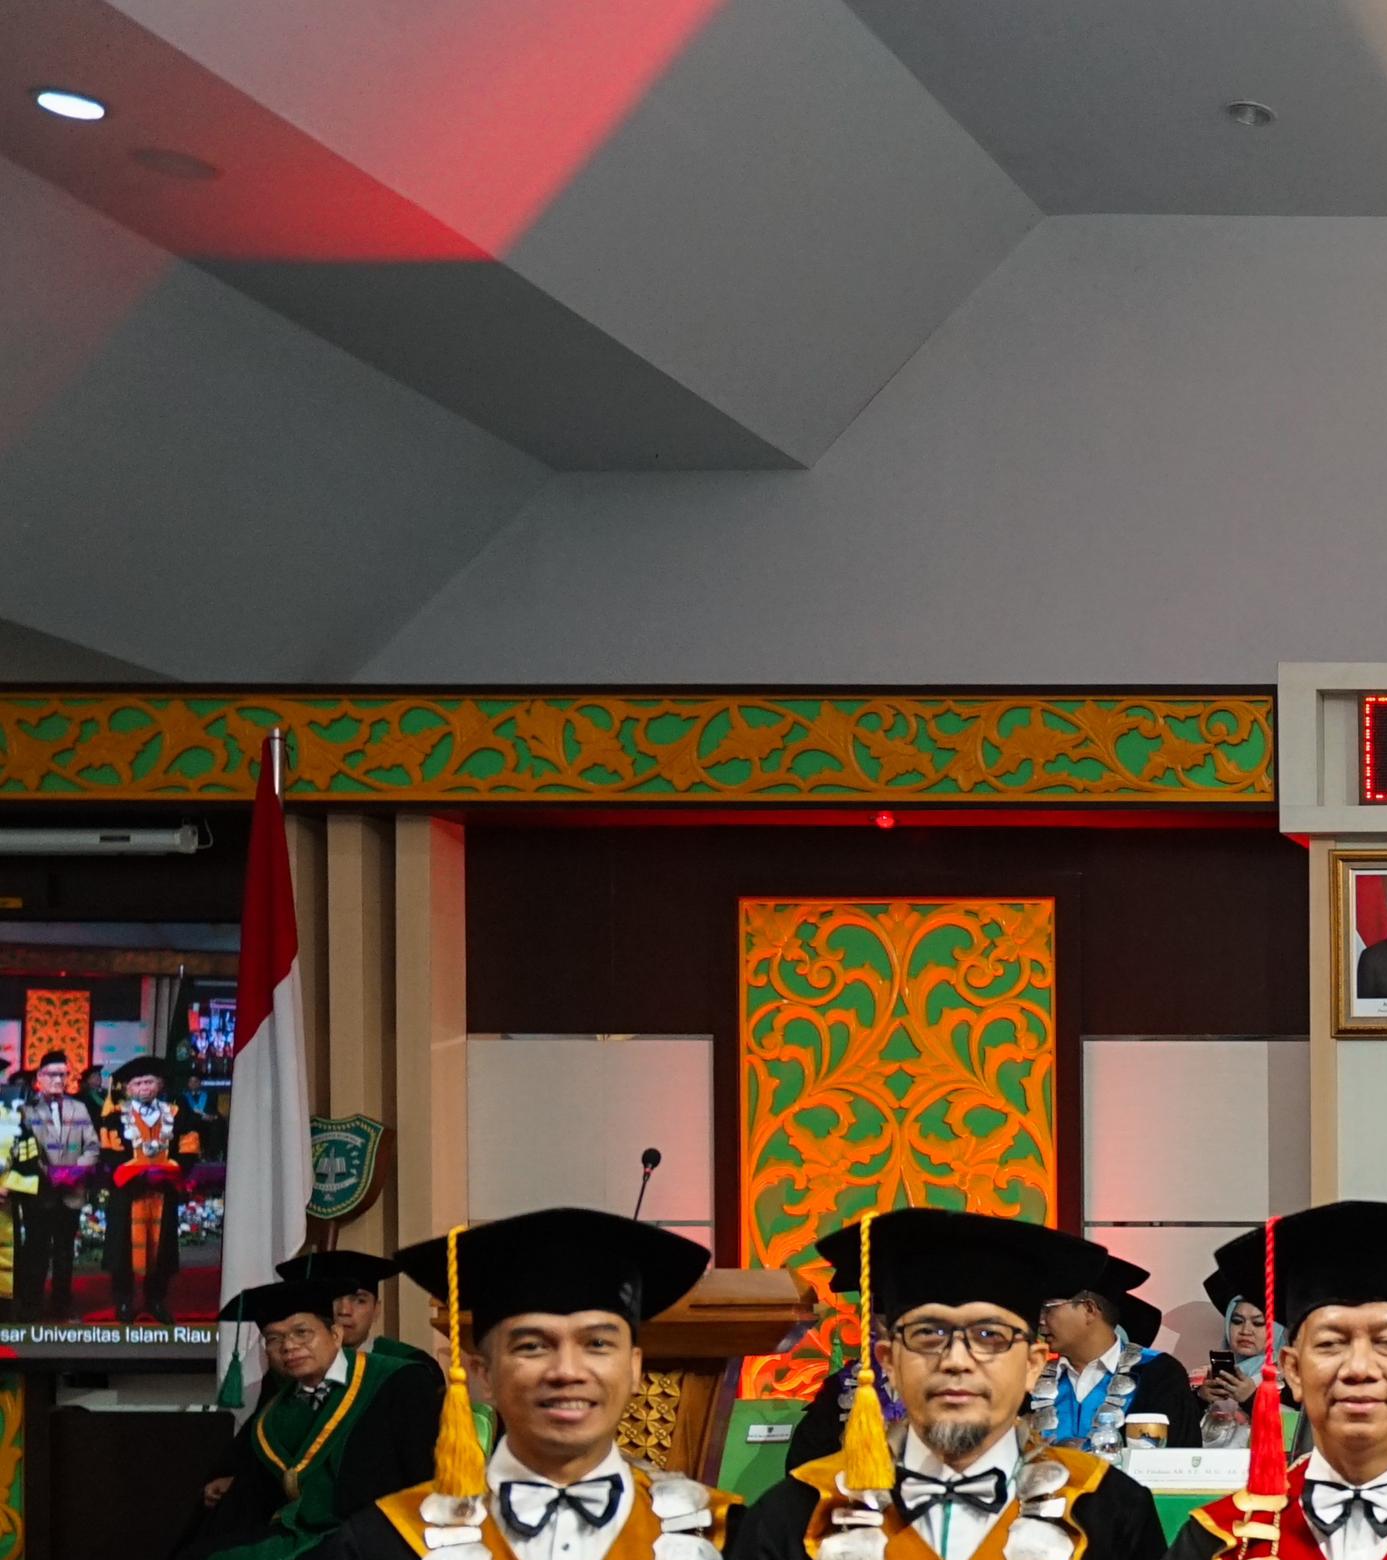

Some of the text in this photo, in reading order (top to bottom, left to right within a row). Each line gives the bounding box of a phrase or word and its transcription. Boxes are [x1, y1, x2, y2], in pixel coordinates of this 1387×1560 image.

[30, 1325, 121, 1343] Universitas
[126, 1325, 169, 1343] Islam
[174, 1325, 211, 1343] Riau
